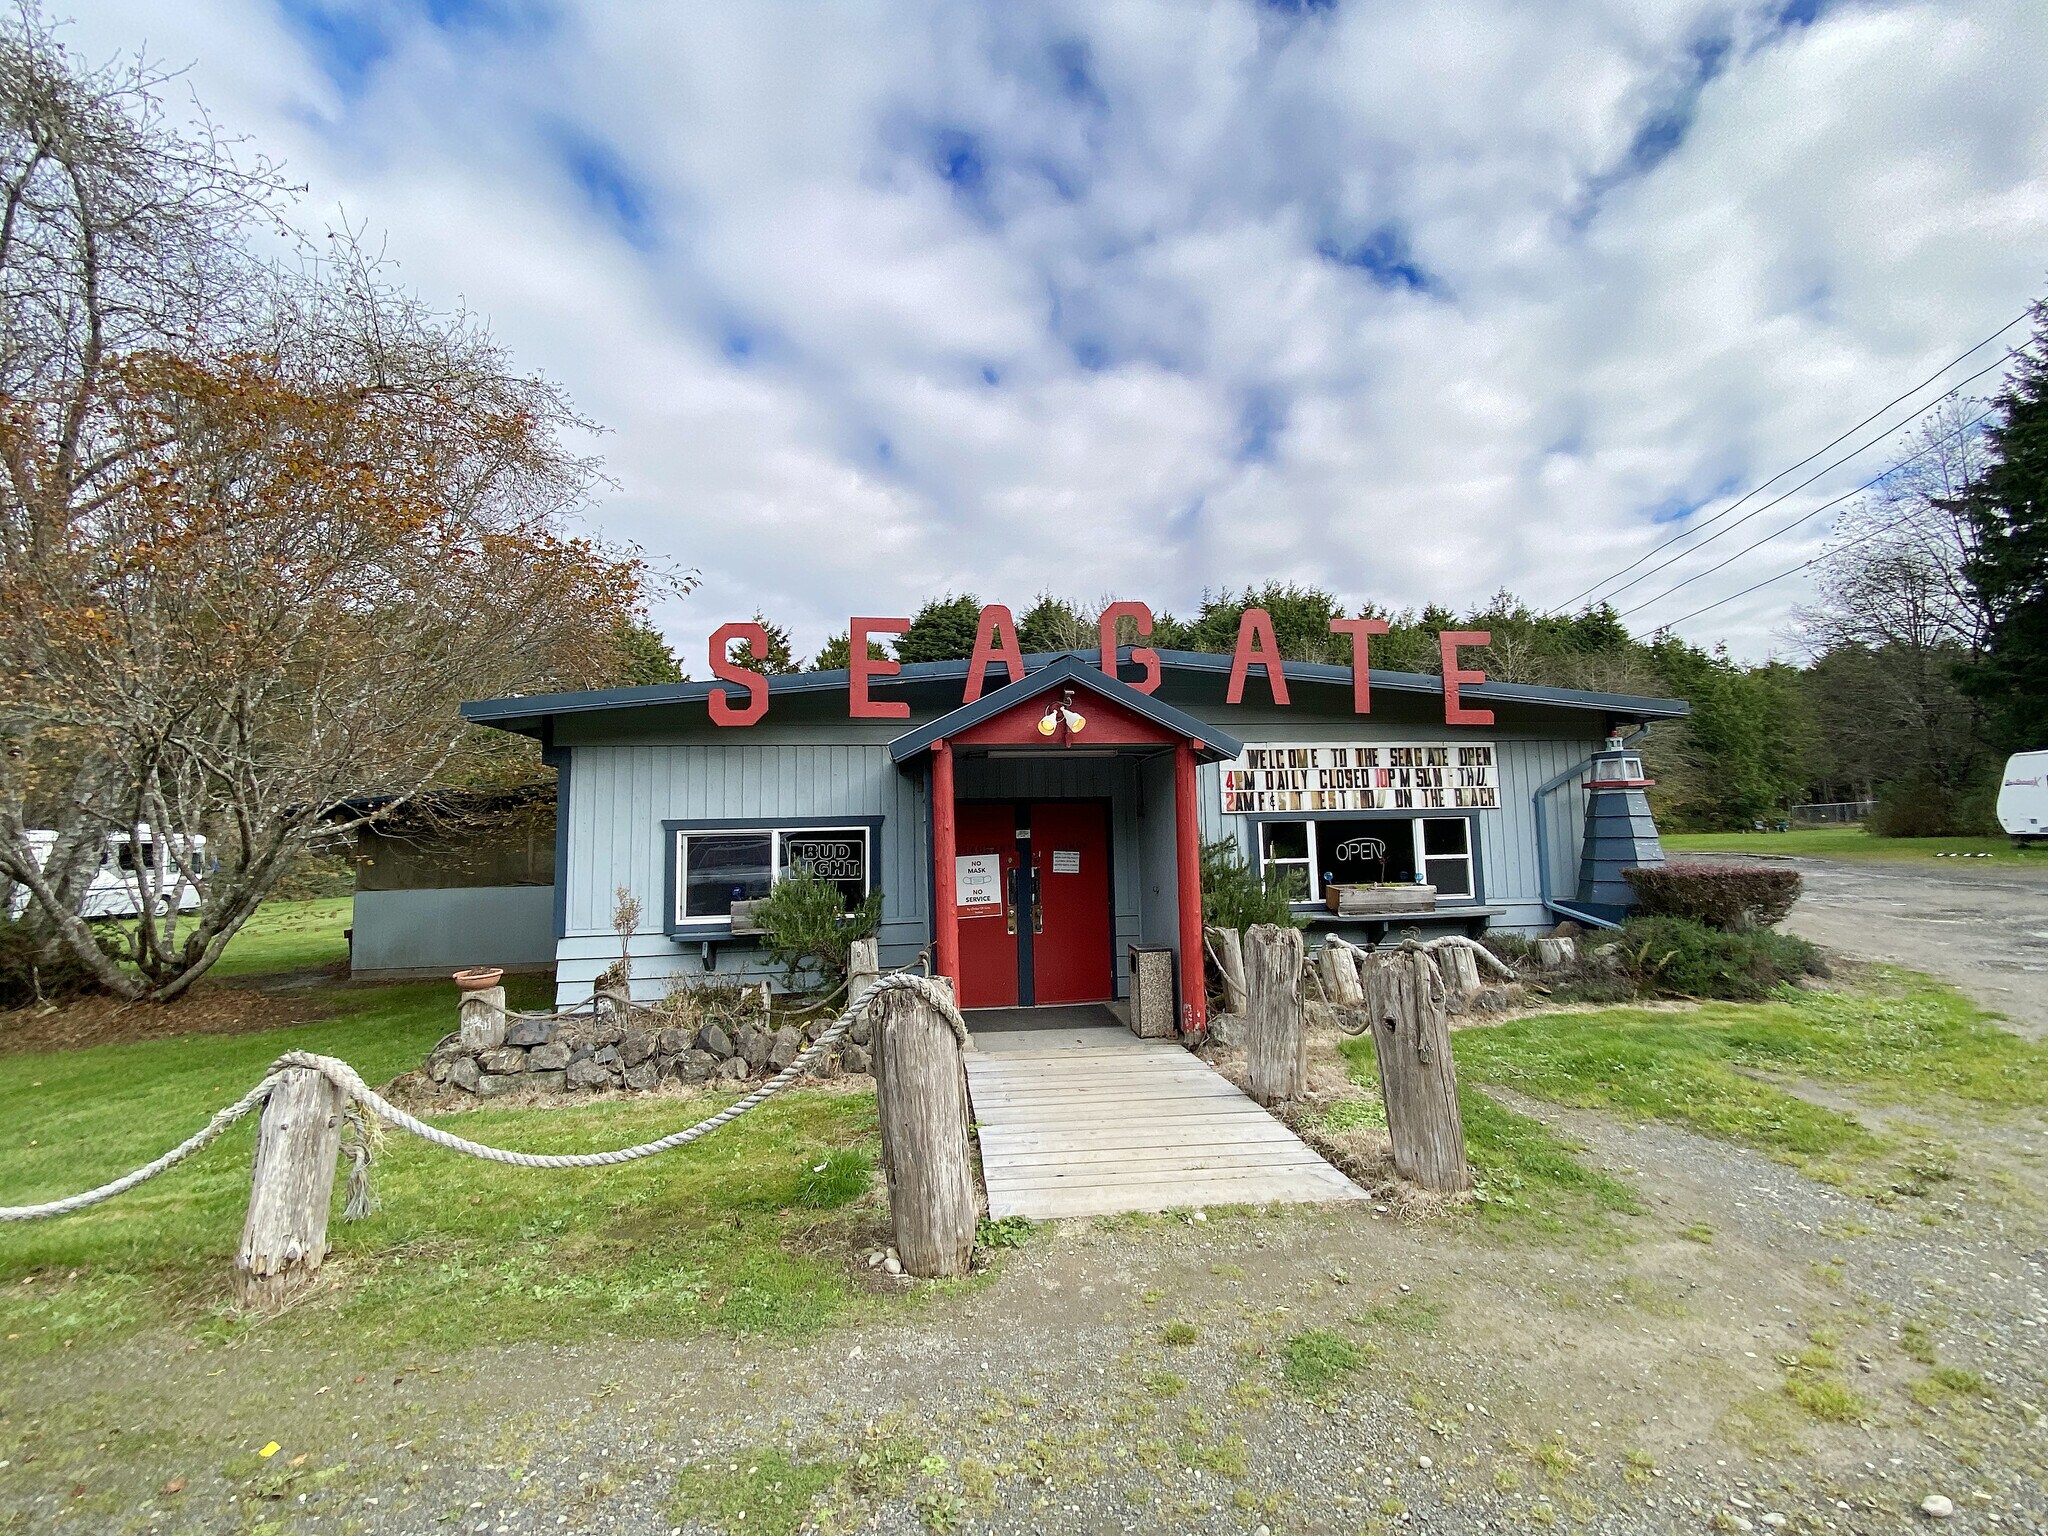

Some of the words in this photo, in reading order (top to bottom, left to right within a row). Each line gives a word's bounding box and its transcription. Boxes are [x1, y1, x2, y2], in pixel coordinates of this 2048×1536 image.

[708, 601, 1495, 727] SEAGATE
[1246, 749, 1318, 769] WELCOME
[1331, 748, 1347, 768] TO
[1355, 748, 1378, 767] THE
[1389, 747, 1449, 767] SEAGATE
[1458, 747, 1492, 766] OPEN
[1225, 770, 1255, 790] 4PM
[1265, 770, 1308, 790] DAILY
[1319, 769, 1370, 789] CLOSED
[1415, 768, 1443, 788] SUN
[1225, 791, 1255, 812] 2AM
[1311, 790, 1347, 810] EST
[1395, 788, 1413, 808] ON
[1421, 788, 1445, 807] THE
[1454, 787, 1496, 807] BEACH
[802, 843, 850, 860] BUD
[1335, 841, 1385, 862] OPEN
[793, 860, 860, 877] IGHT
[965, 895, 991, 903] SERVICE
